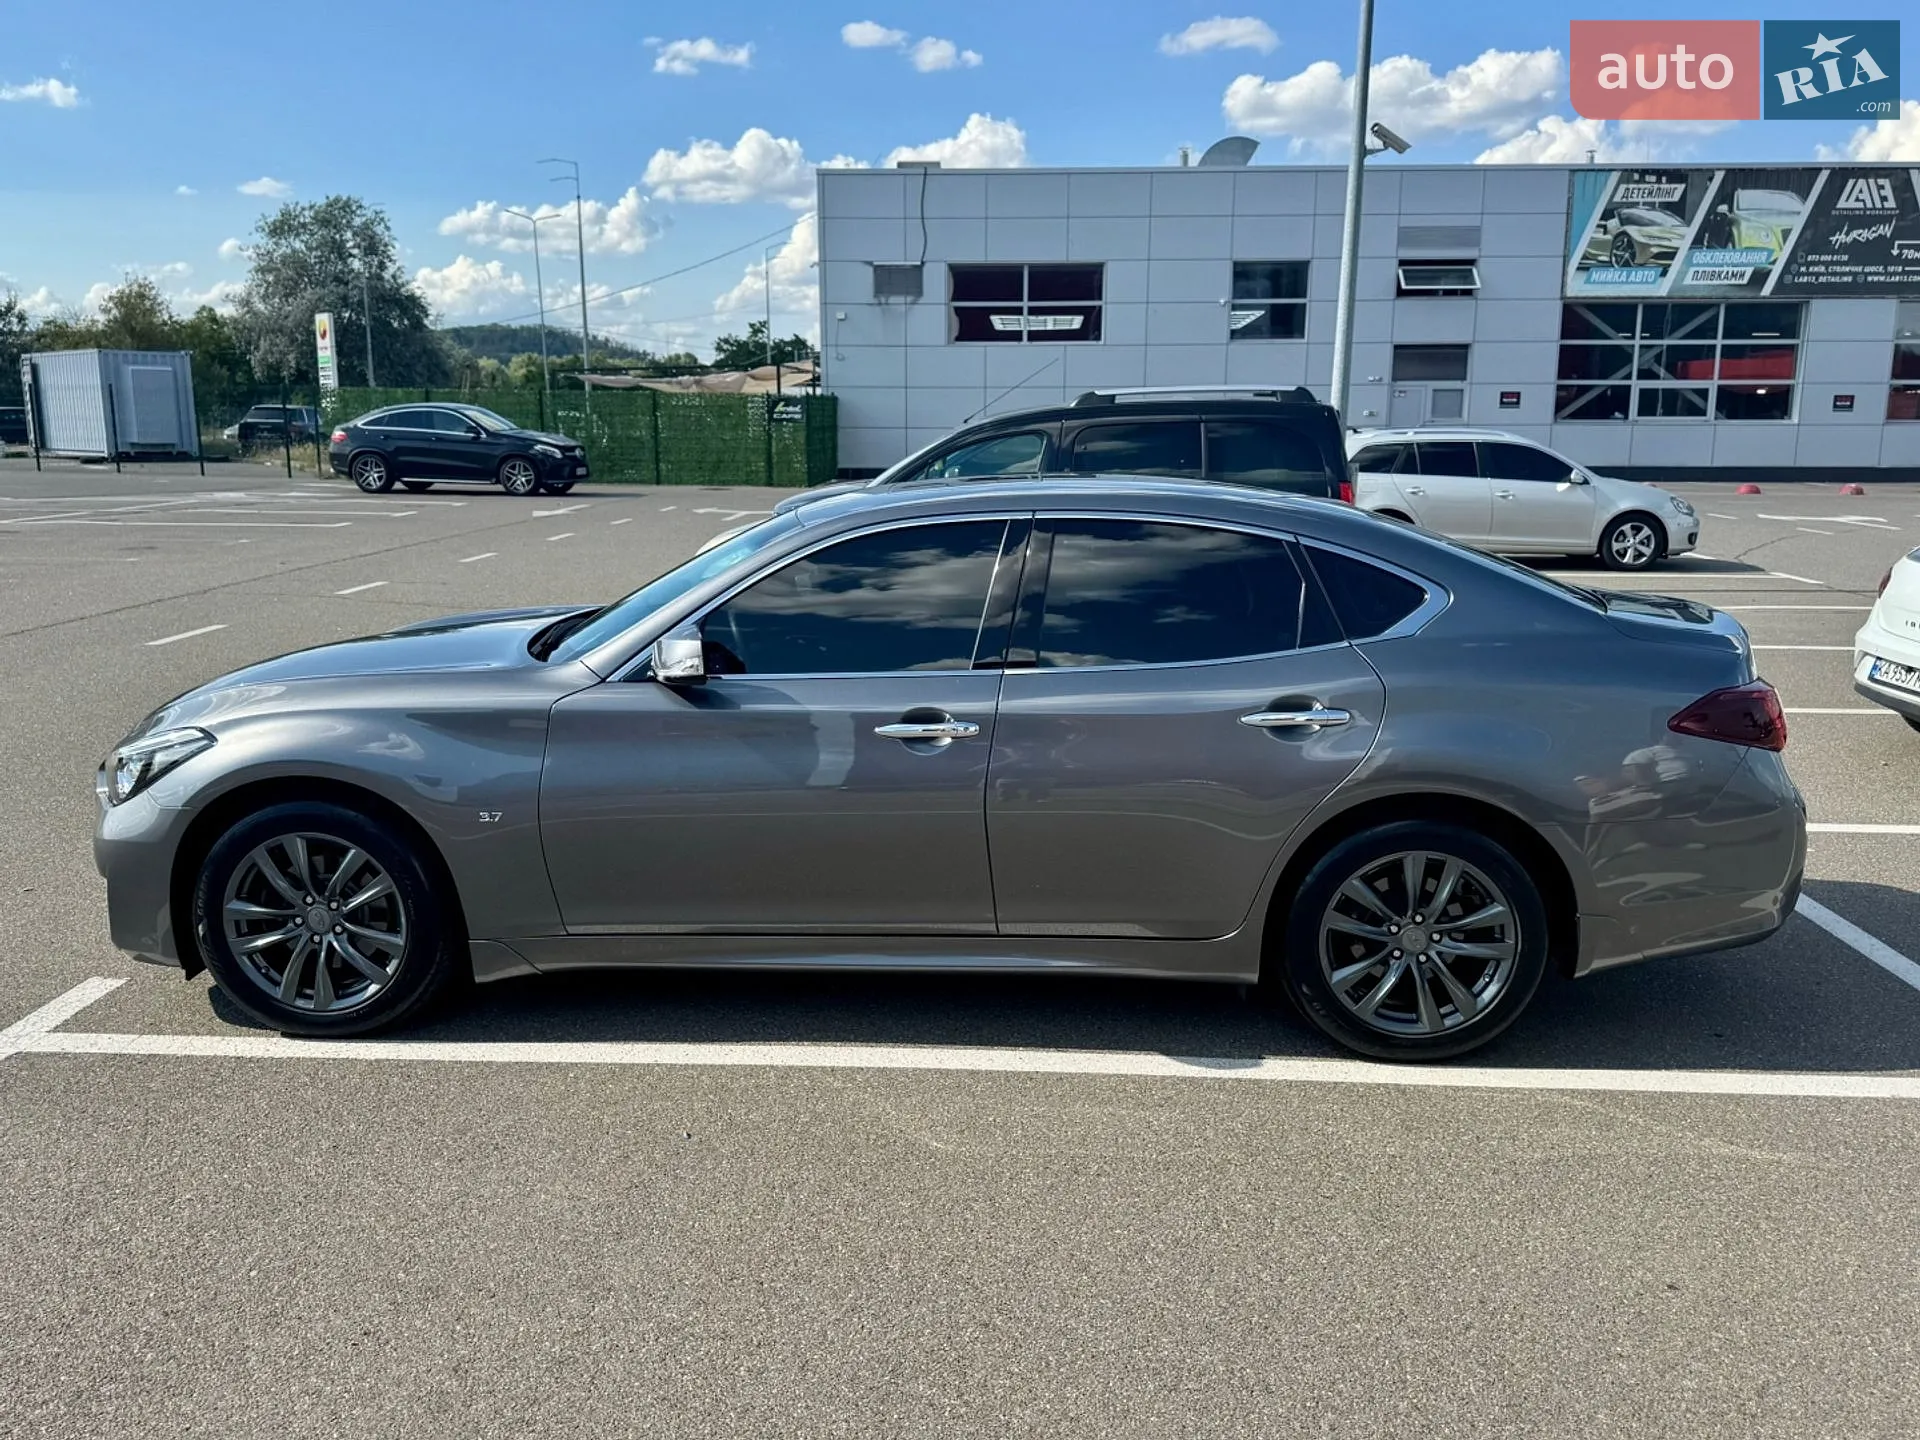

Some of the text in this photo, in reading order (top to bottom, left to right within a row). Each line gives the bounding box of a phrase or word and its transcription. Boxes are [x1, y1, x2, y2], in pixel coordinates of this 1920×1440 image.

[1621, 186, 1679, 200] ДЕТЕЙЛІНГ
[1692, 251, 1768, 264] ОБКЛЕЮВАННЯ
[1591, 268, 1656, 282] МИЙКА АВТО
[1691, 269, 1746, 281] ПЛІВКАМИ
[480, 812, 502, 822] 3.7
